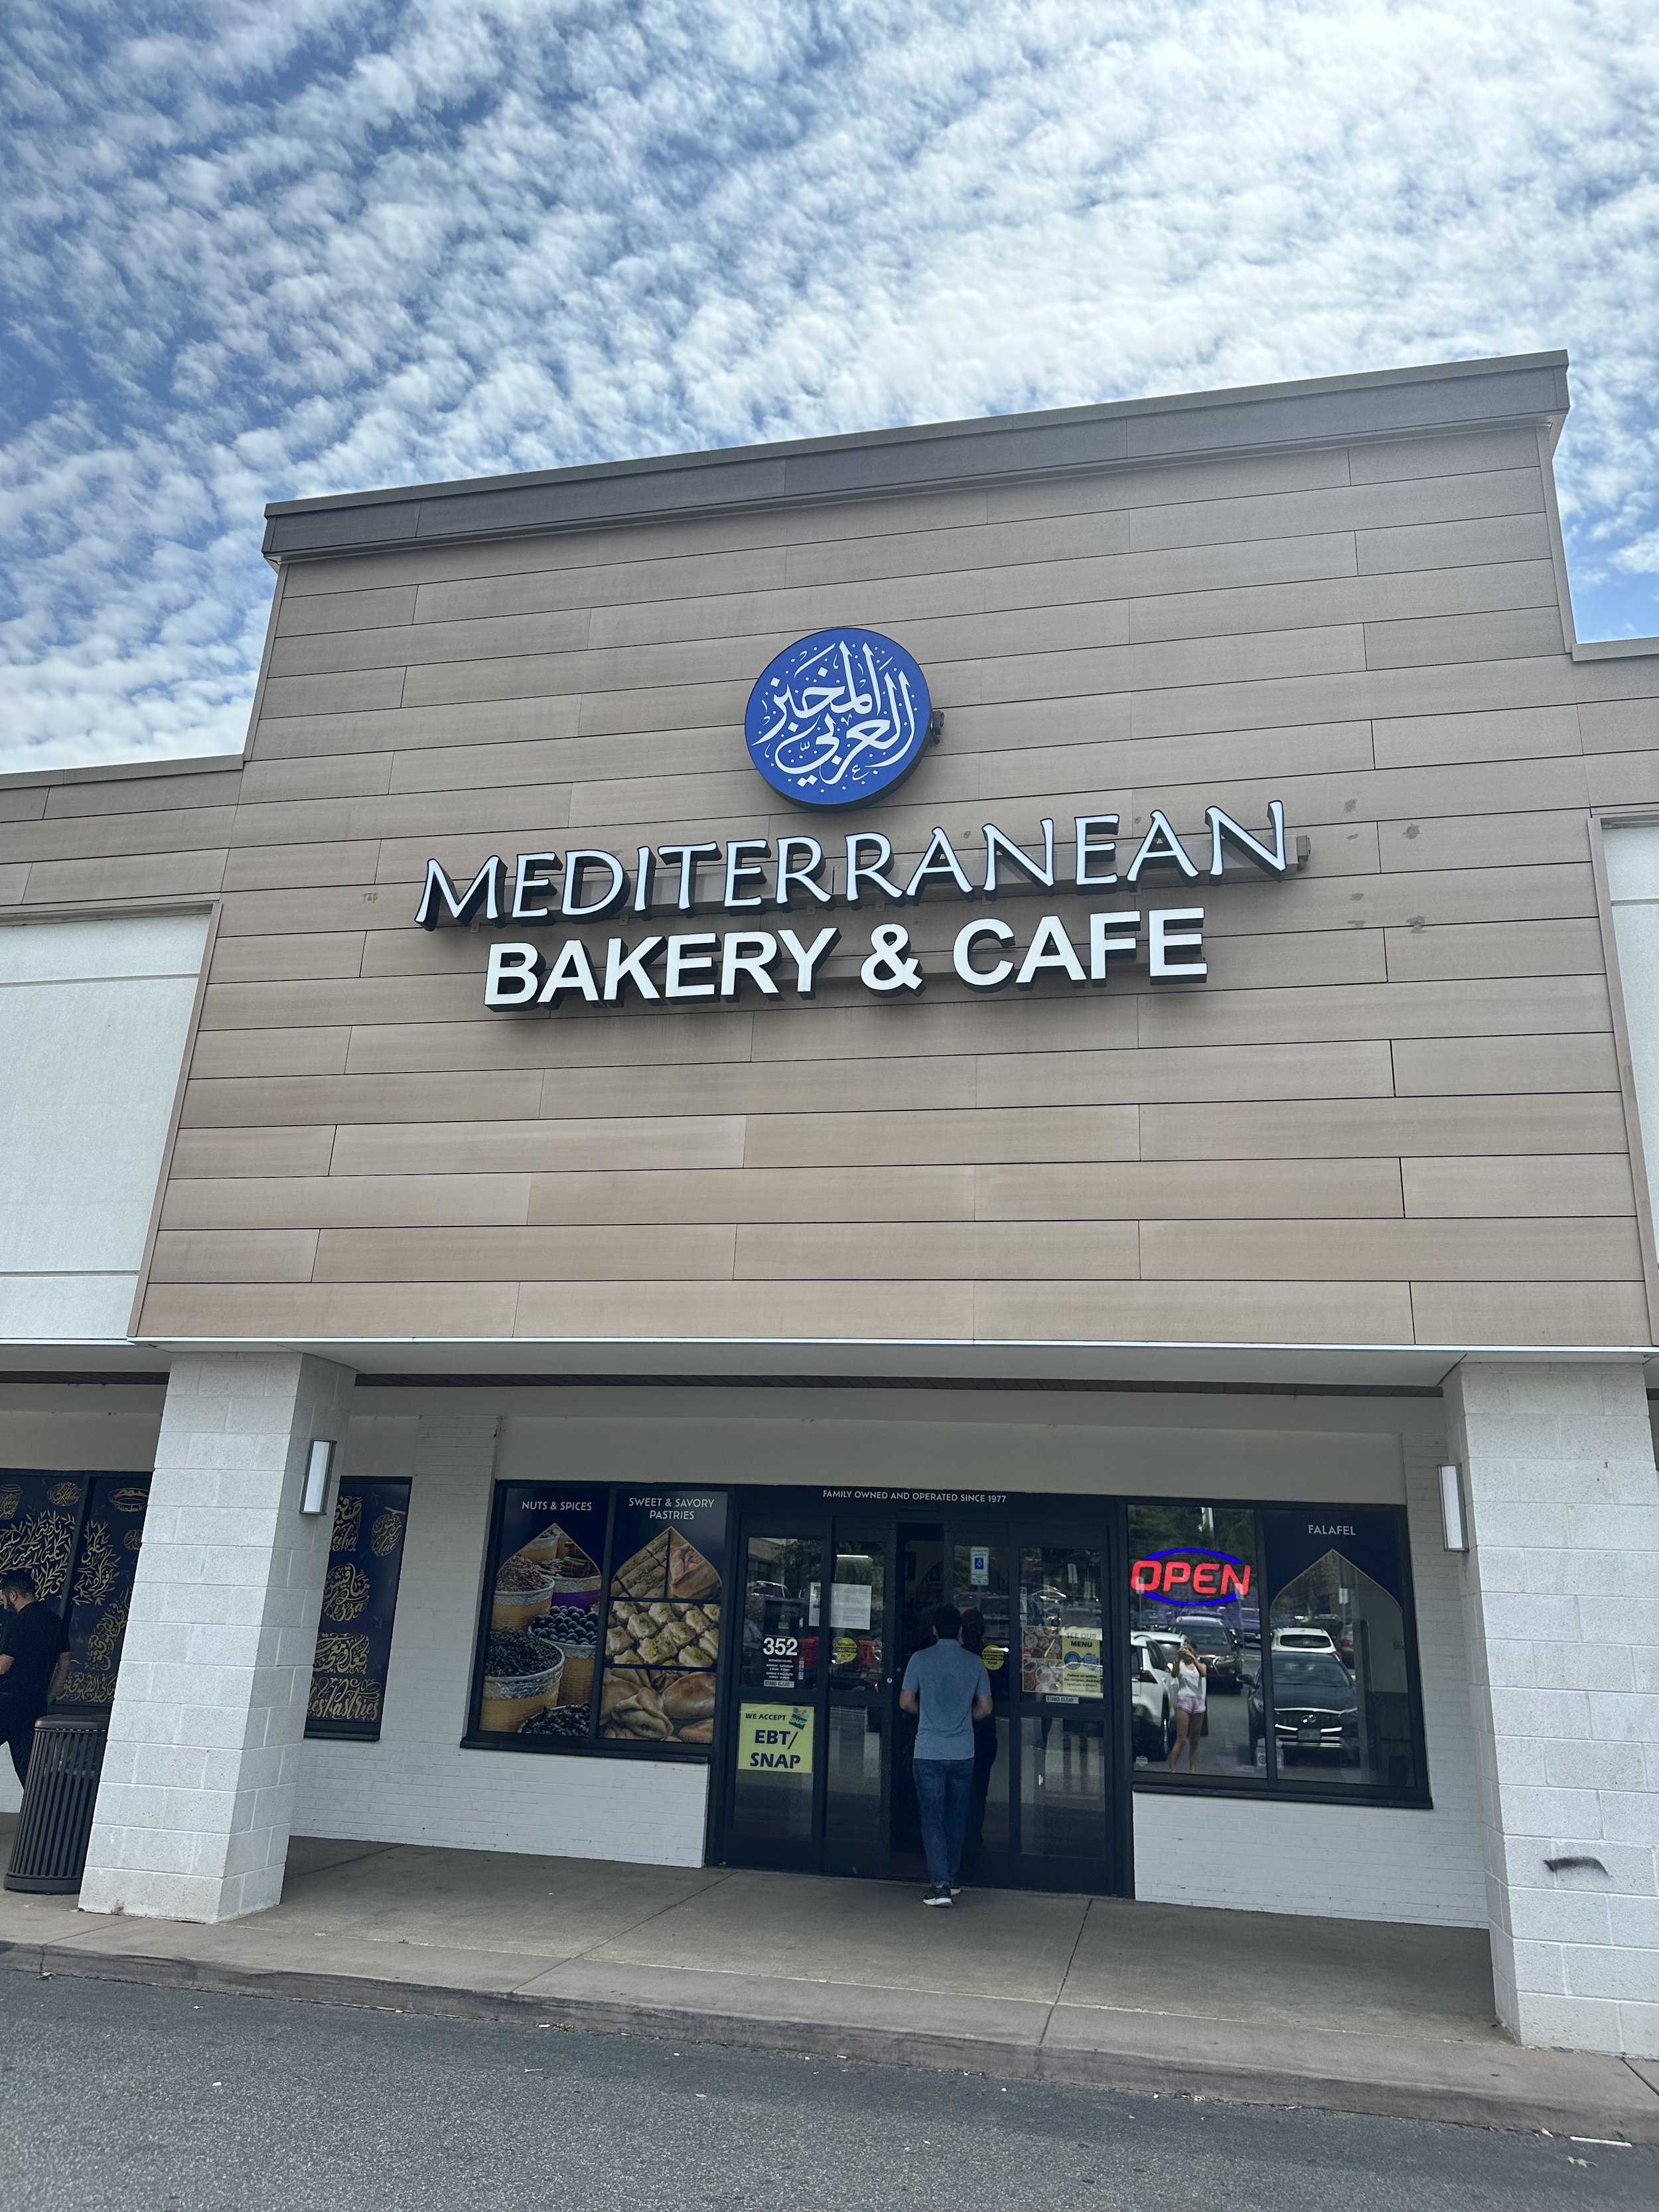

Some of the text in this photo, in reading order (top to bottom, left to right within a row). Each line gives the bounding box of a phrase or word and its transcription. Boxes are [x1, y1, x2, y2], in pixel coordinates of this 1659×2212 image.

[414, 801, 1287, 927] MEDITERRANEAN
[484, 907, 1208, 1007] BAKERY & CAFE
[628, 1497, 715, 1508] SWEET & SAVORY
[855, 1491, 888, 1499] OWNED
[912, 1493, 958, 1501] OPERATED
[522, 1501, 592, 1511] NUTS & SPICES
[649, 1510, 695, 1520] PASTRIES
[1308, 1524, 1356, 1536] FALAFEL
[1130, 1560, 1251, 1595] OPEN
[763, 1637, 798, 1655] 352
[755, 1730, 798, 1749] EBT/
[750, 1752, 800, 1769] SNAP
